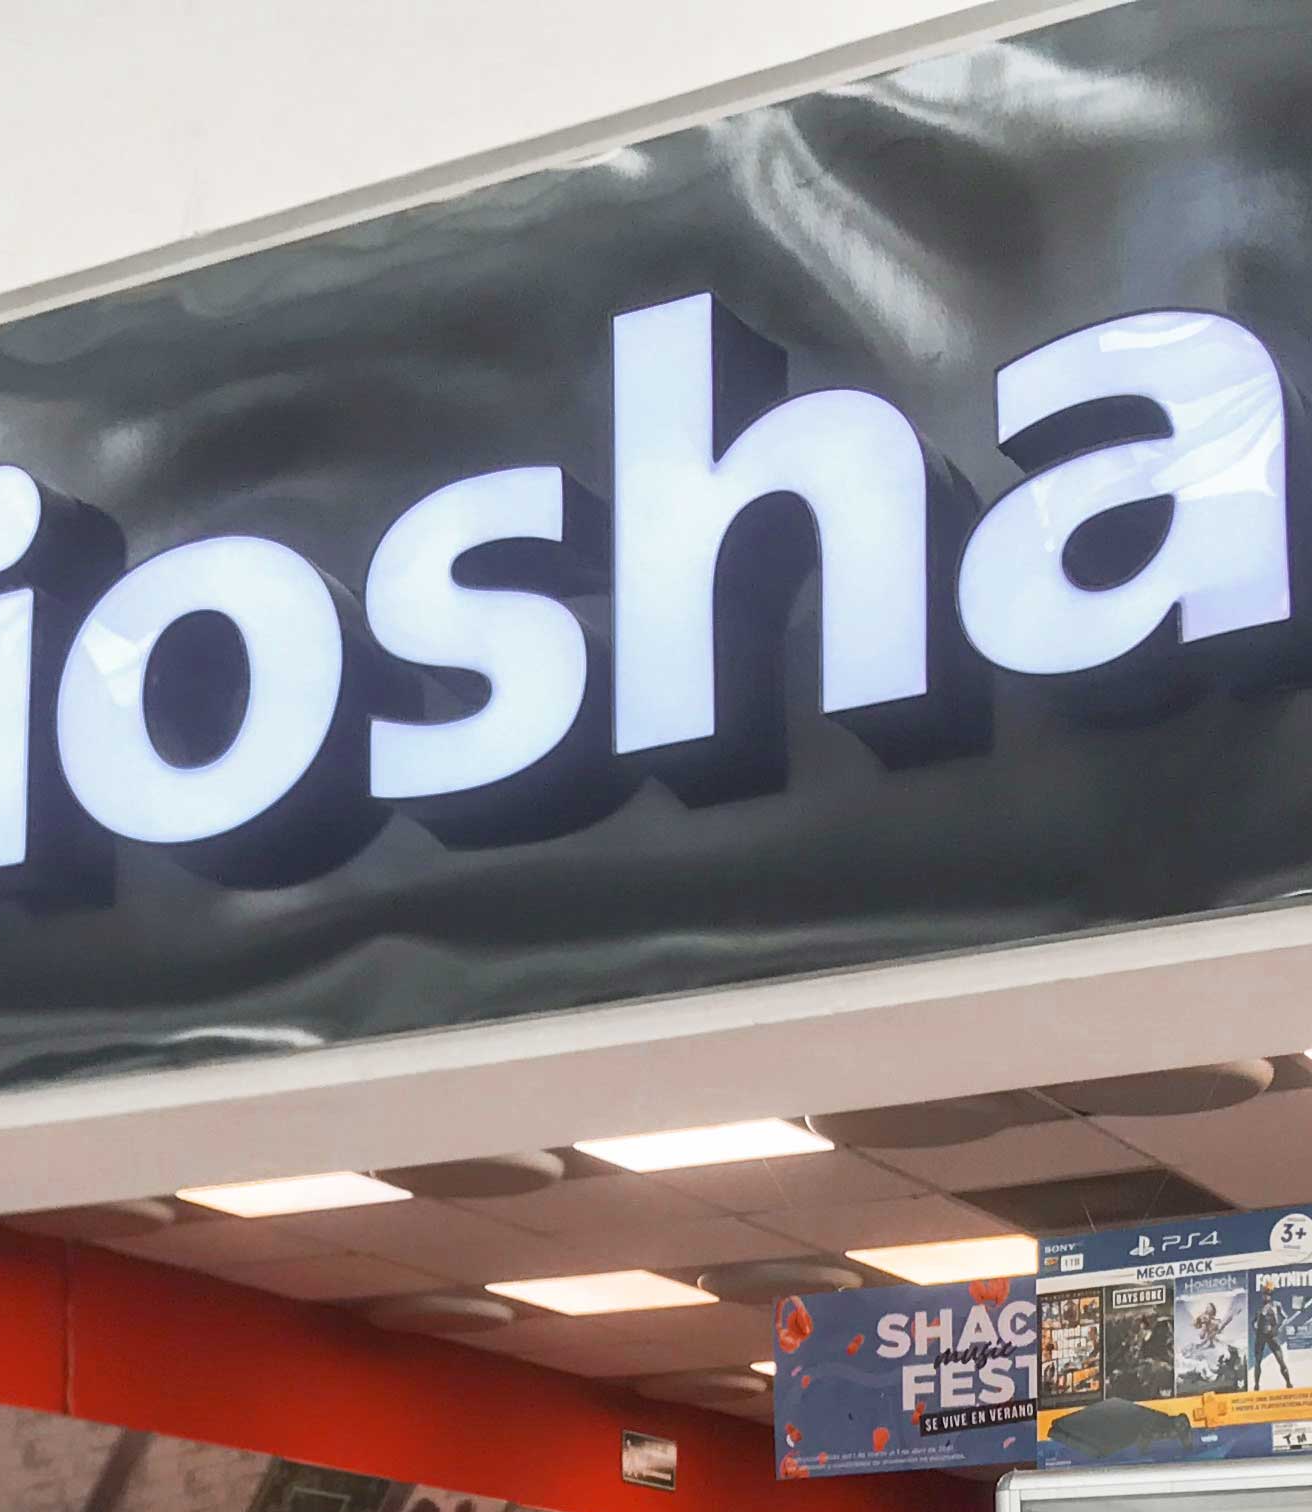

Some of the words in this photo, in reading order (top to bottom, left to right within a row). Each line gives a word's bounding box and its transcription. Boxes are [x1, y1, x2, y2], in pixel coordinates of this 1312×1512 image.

[1161, 1229, 1222, 1252] PS4
[1279, 1221, 1307, 1244] 3+
[1043, 1242, 1076, 1254] SONY
[1136, 1262, 1176, 1281] MEGA
[1178, 1258, 1214, 1275] PACK
[1116, 1292, 1138, 1305] DAYS
[1139, 1289, 1163, 1302] GONE
[933, 1338, 1019, 1370] music
[901, 1353, 1038, 1412] FEST
[924, 1417, 939, 1432] SE
[942, 1412, 968, 1429] VIVE
[971, 1411, 986, 1425] EN
[989, 1403, 1035, 1422] VERANO
